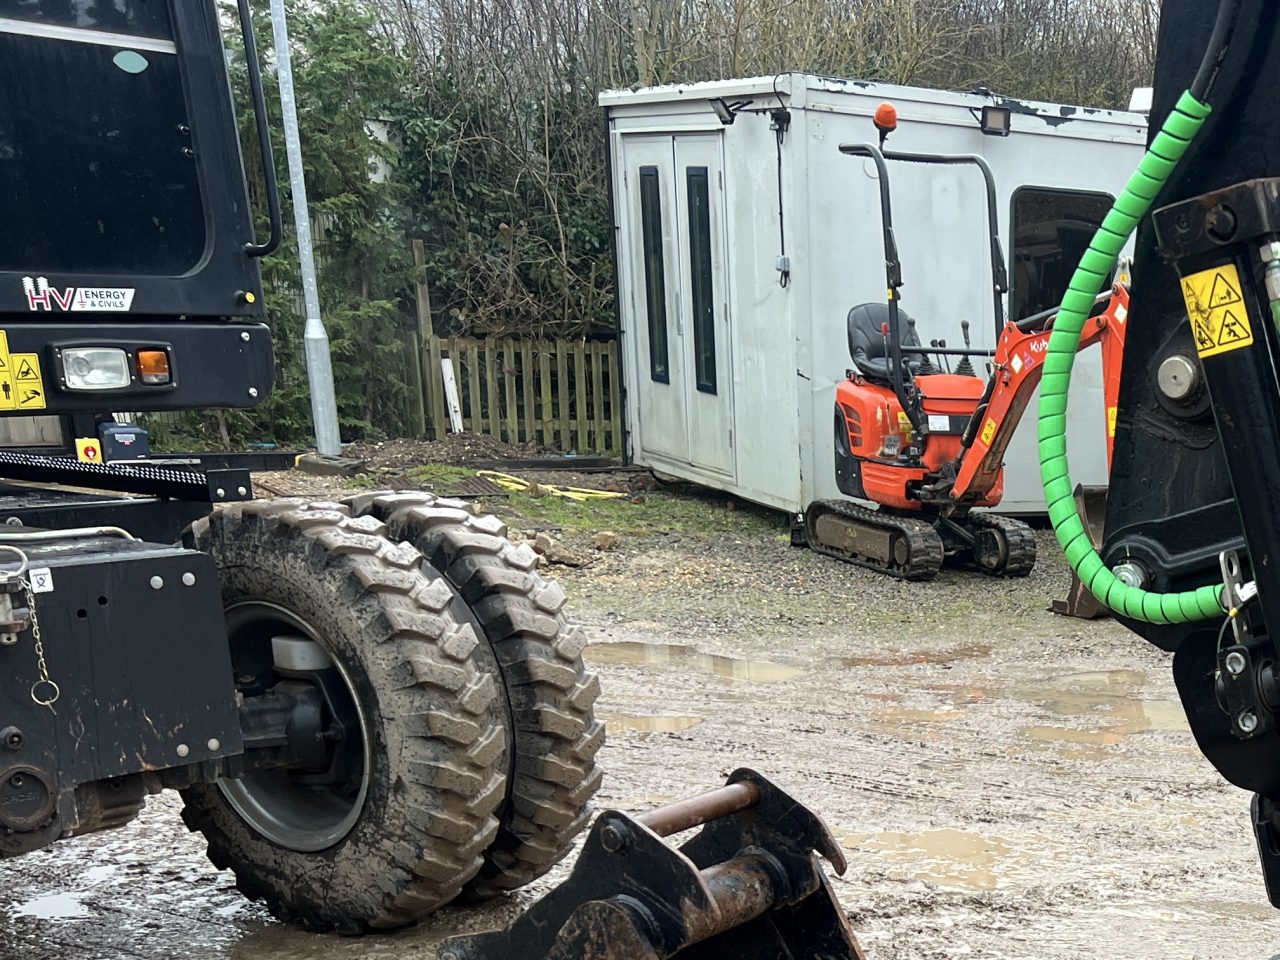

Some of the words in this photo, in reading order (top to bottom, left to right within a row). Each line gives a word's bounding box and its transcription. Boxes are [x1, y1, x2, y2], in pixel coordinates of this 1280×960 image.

[23, 277, 74, 311] HV
[84, 290, 126, 300] ENERGY
[98, 300, 125, 308] CIVILS
[1030, 338, 1049, 352] Kub
